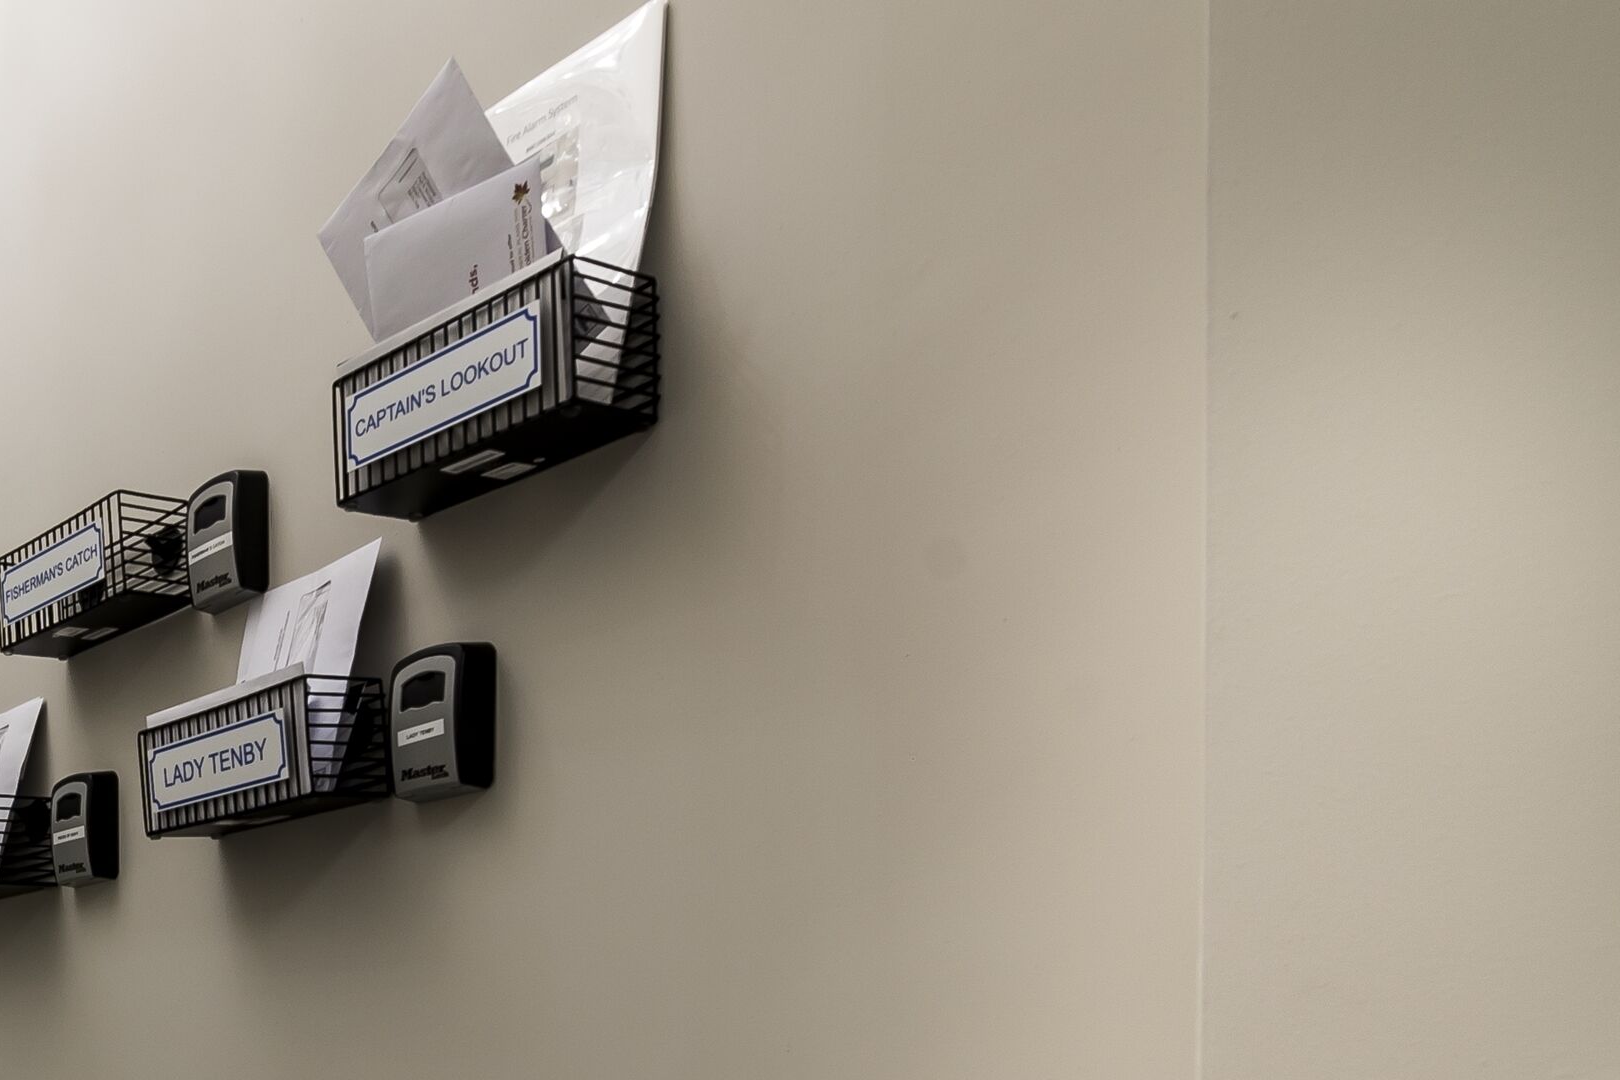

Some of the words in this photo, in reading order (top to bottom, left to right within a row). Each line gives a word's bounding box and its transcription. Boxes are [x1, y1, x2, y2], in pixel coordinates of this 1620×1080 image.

[547, 94, 579, 120] System
[355, 384, 436, 437] CAPTAIN'S
[441, 338, 528, 397] LOOKOUT
[5, 562, 63, 603] FISHERMAN'S
[65, 544, 98, 572] CATCH
[164, 756, 204, 788] LADY
[208, 738, 266, 774] TENBY
[401, 764, 446, 781] Master
